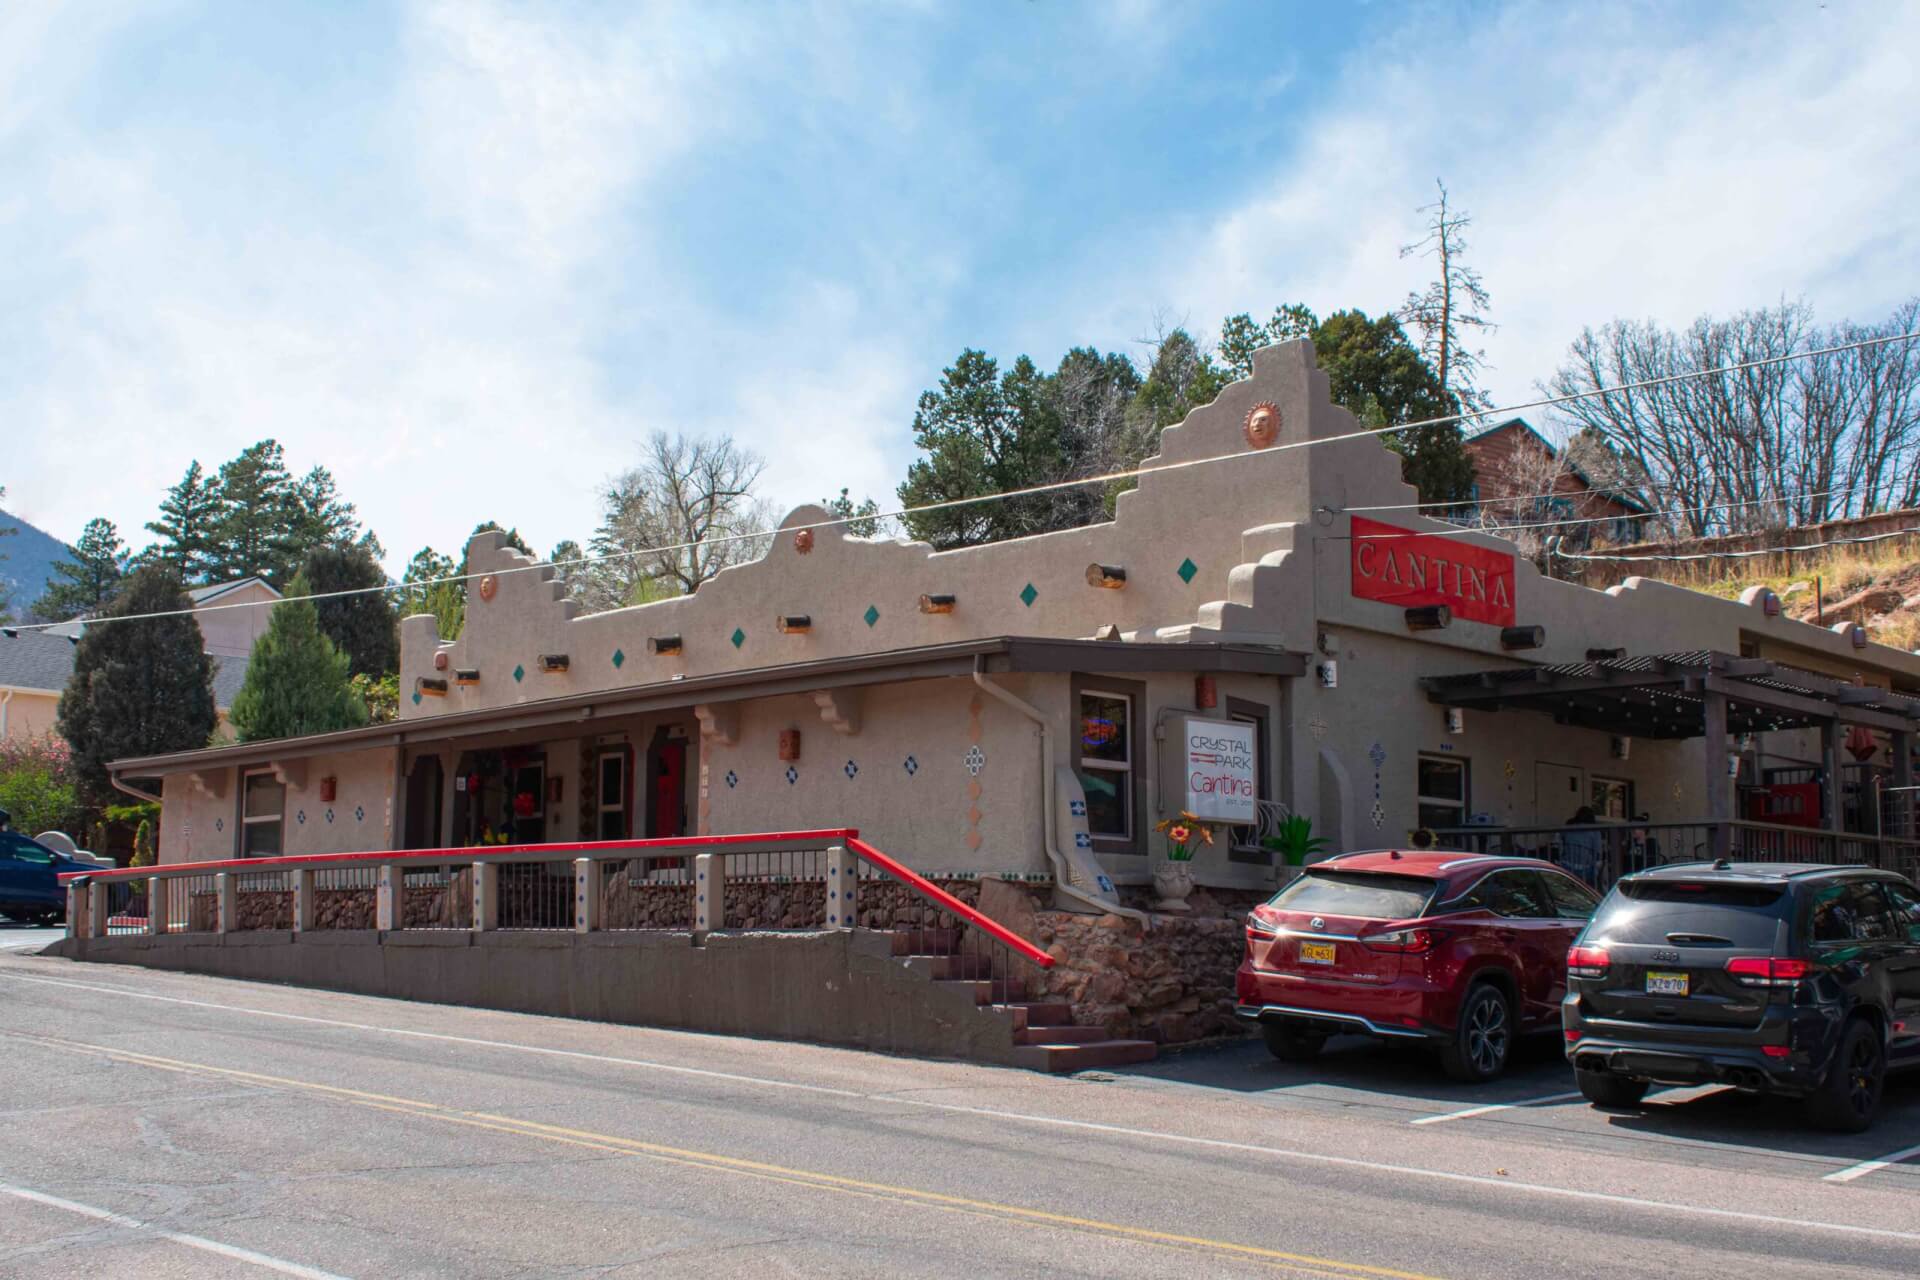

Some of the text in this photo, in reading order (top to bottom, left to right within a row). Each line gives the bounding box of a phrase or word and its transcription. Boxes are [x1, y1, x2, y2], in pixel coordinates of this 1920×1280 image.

[1358, 543, 1510, 607] CANTINA
[1190, 736, 1251, 754] CRYSTAL
[1215, 755, 1251, 770] PARK
[1190, 771, 1252, 796] Cantina
